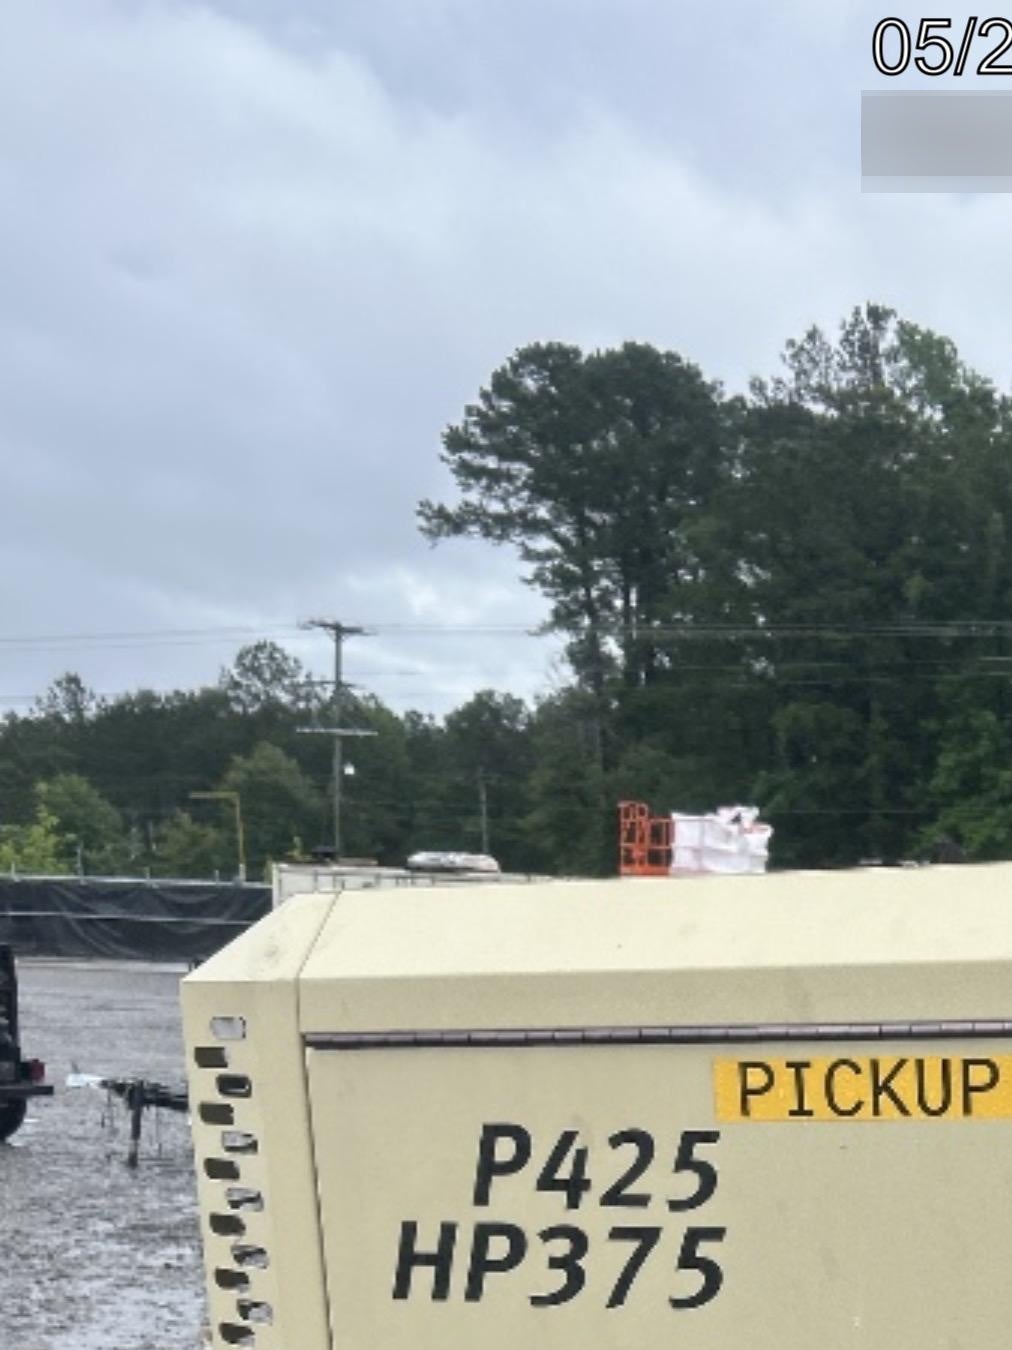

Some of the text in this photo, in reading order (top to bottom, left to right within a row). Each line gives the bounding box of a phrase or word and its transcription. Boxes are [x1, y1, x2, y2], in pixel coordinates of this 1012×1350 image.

[737, 1058, 1000, 1117] PICKUP
[473, 1123, 721, 1213] P425
[391, 1220, 727, 1310] HP375
